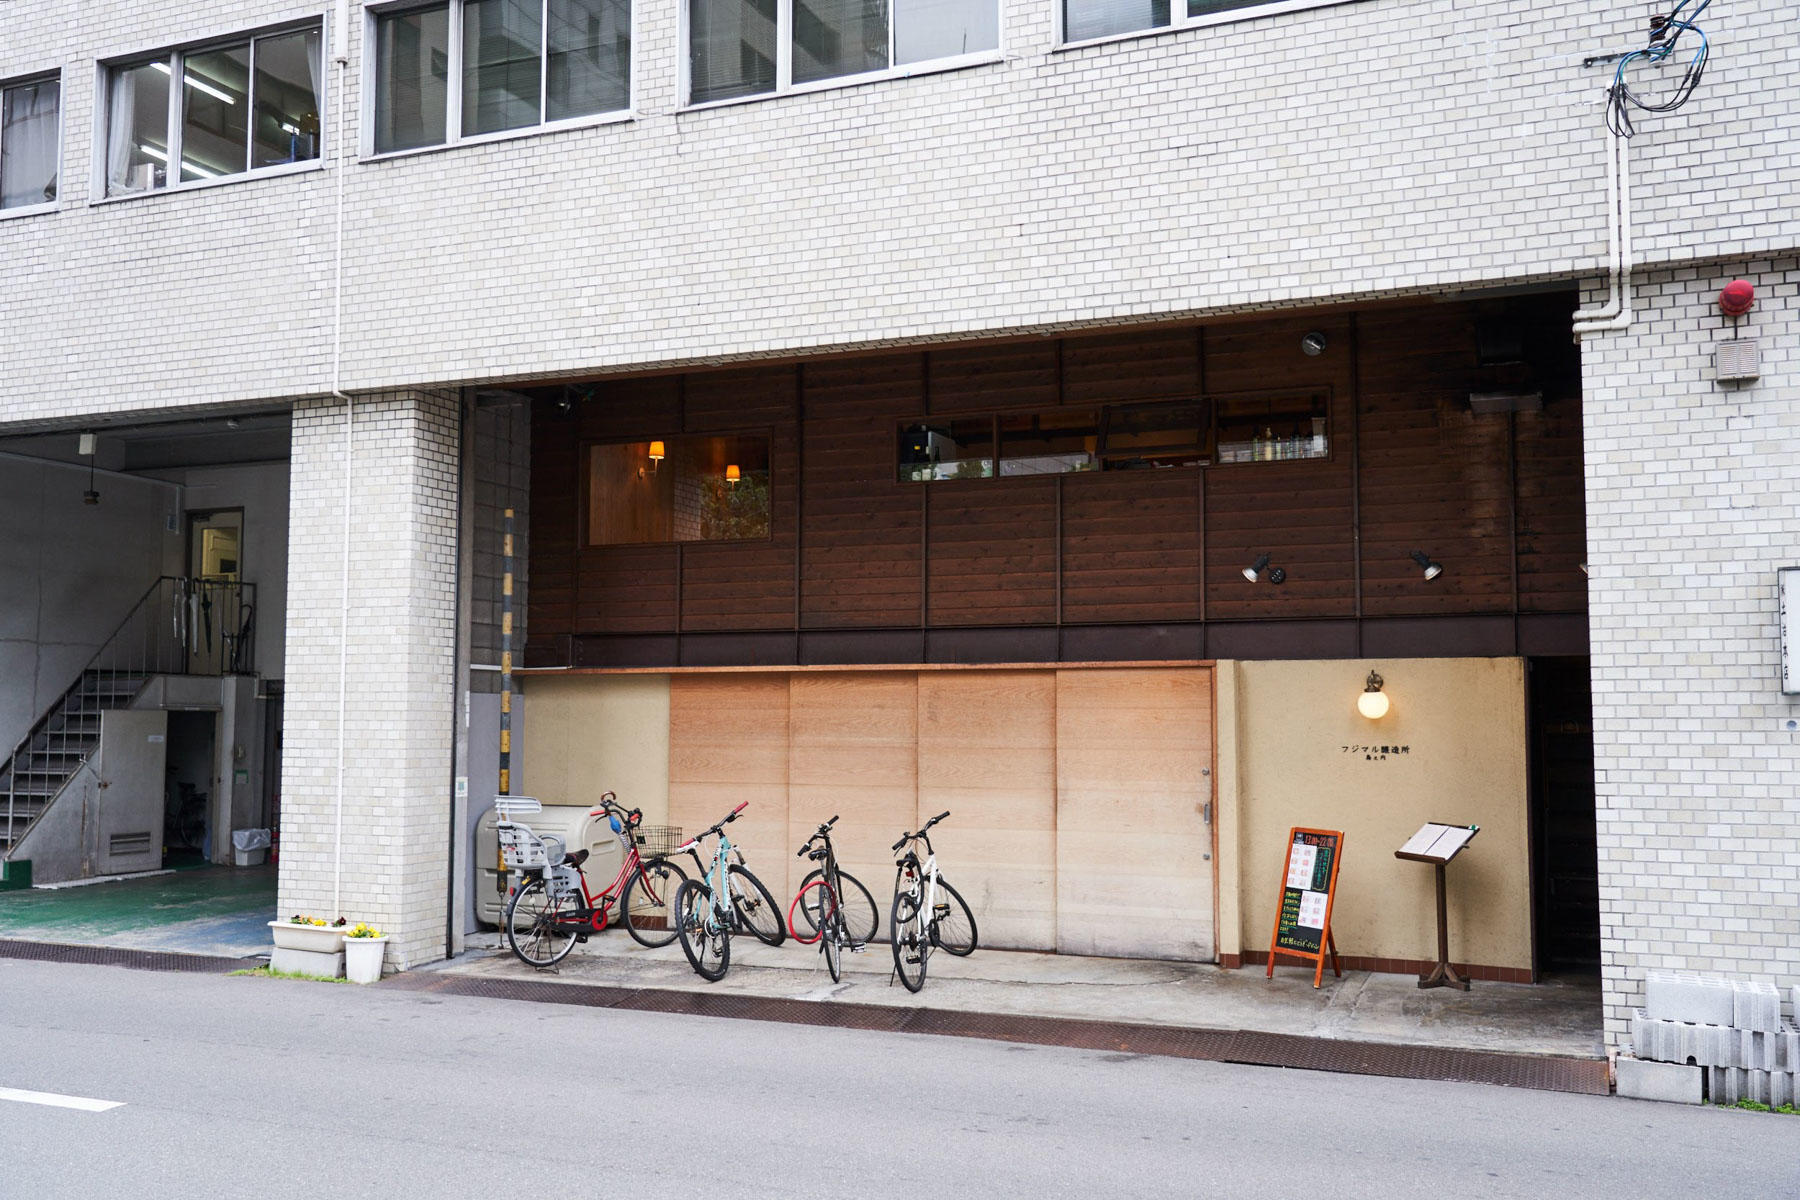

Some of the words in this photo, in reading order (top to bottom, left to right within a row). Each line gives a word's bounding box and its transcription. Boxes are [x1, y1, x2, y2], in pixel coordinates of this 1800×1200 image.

[1341, 744, 1410, 755] フジマル醸造所
